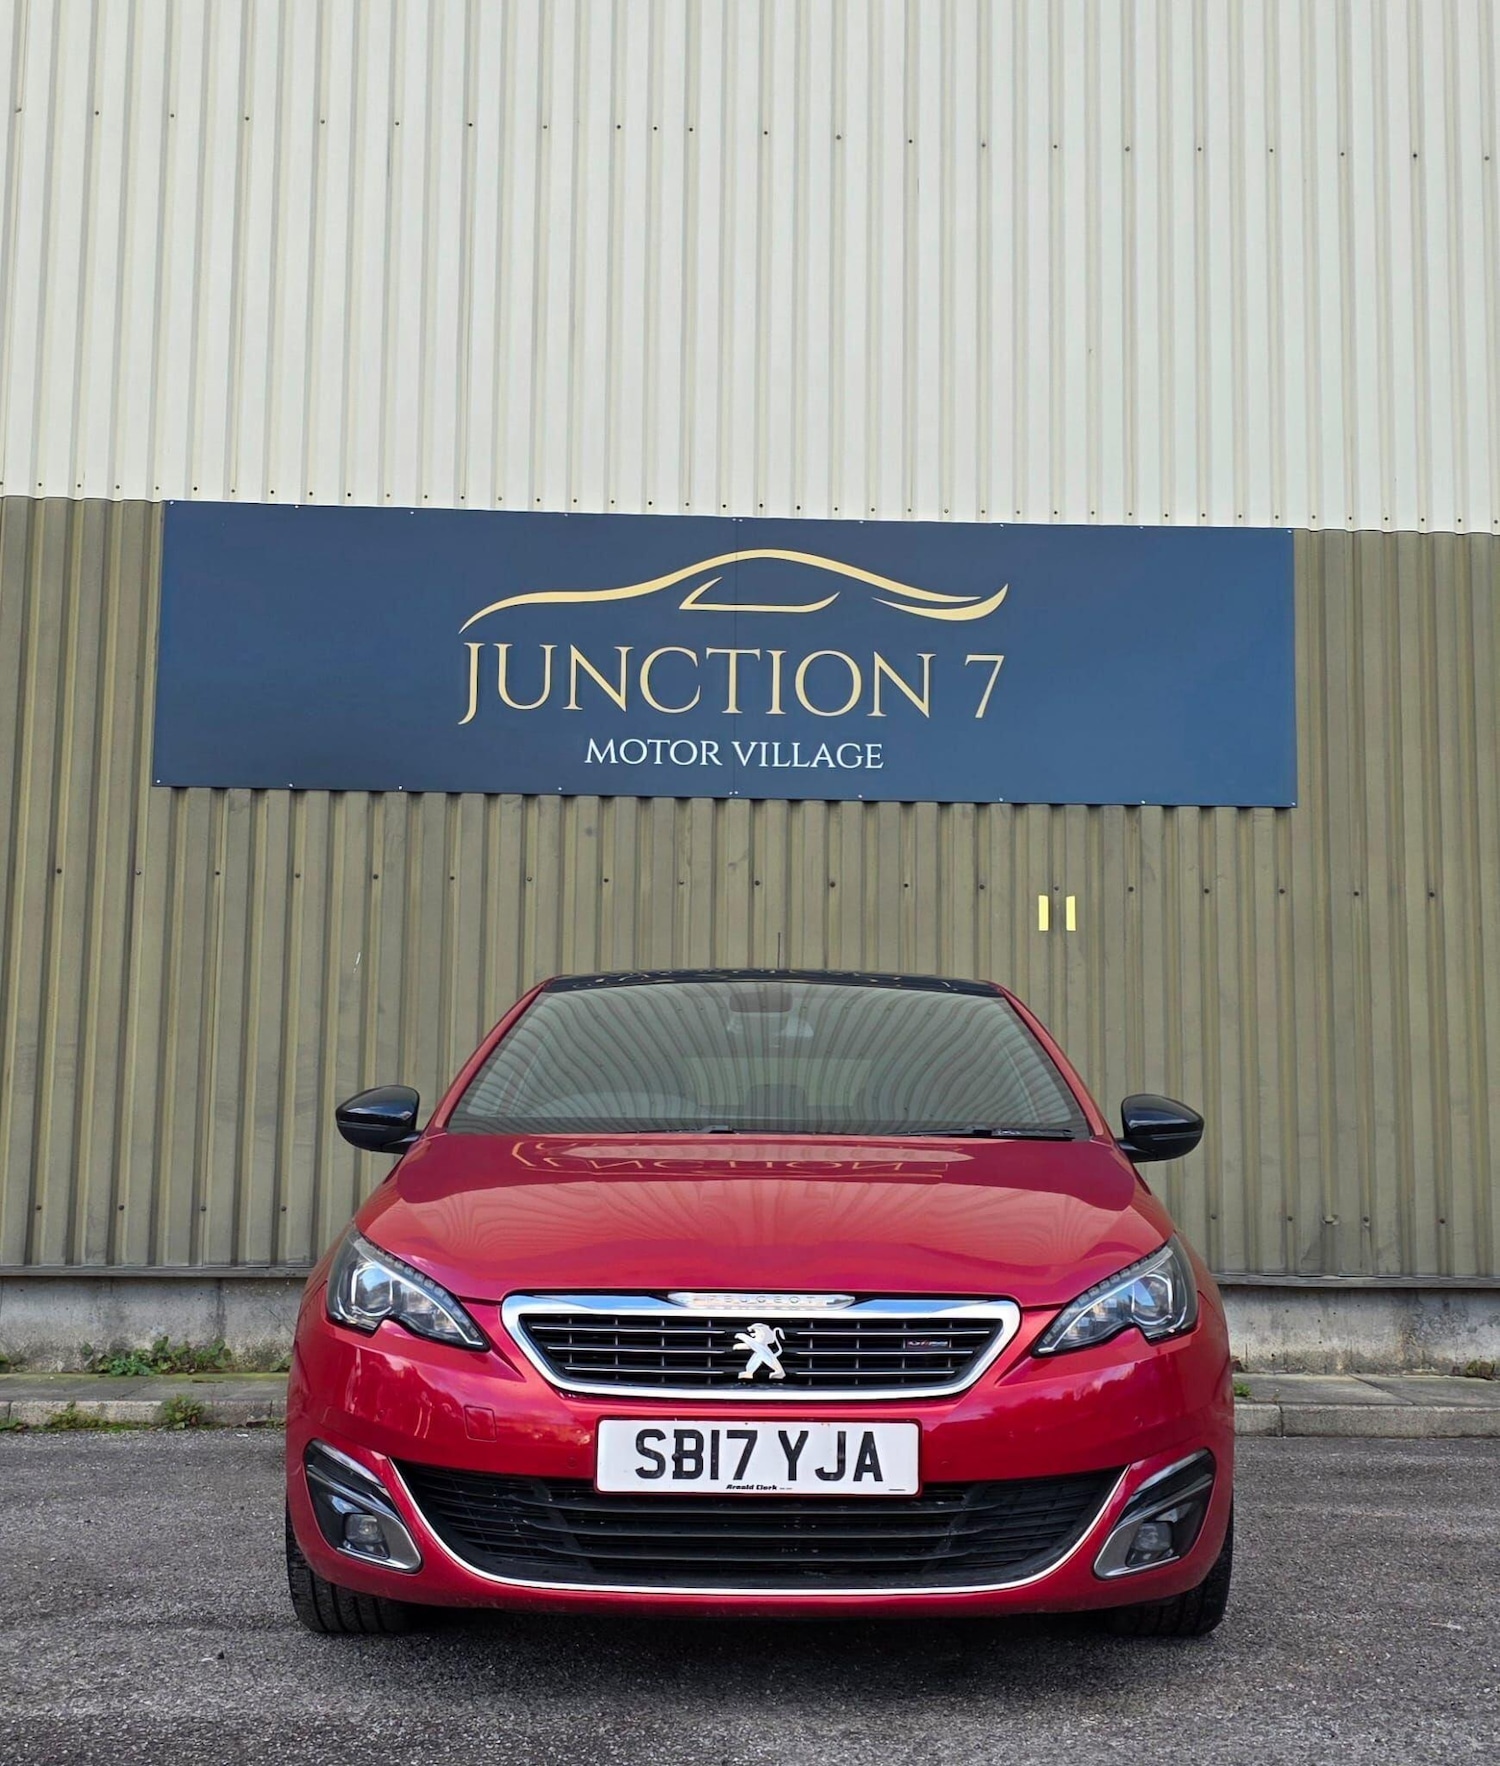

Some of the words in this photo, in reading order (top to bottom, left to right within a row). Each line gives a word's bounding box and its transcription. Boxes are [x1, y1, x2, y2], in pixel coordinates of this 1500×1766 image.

[458, 641, 937, 725] JUNCTION
[964, 653, 1006, 719] 7
[584, 737, 723, 767] MOTOR
[730, 740, 885, 769] VILLAGE
[634, 1428, 758, 1481] SB17
[777, 1429, 884, 1482] YJA
